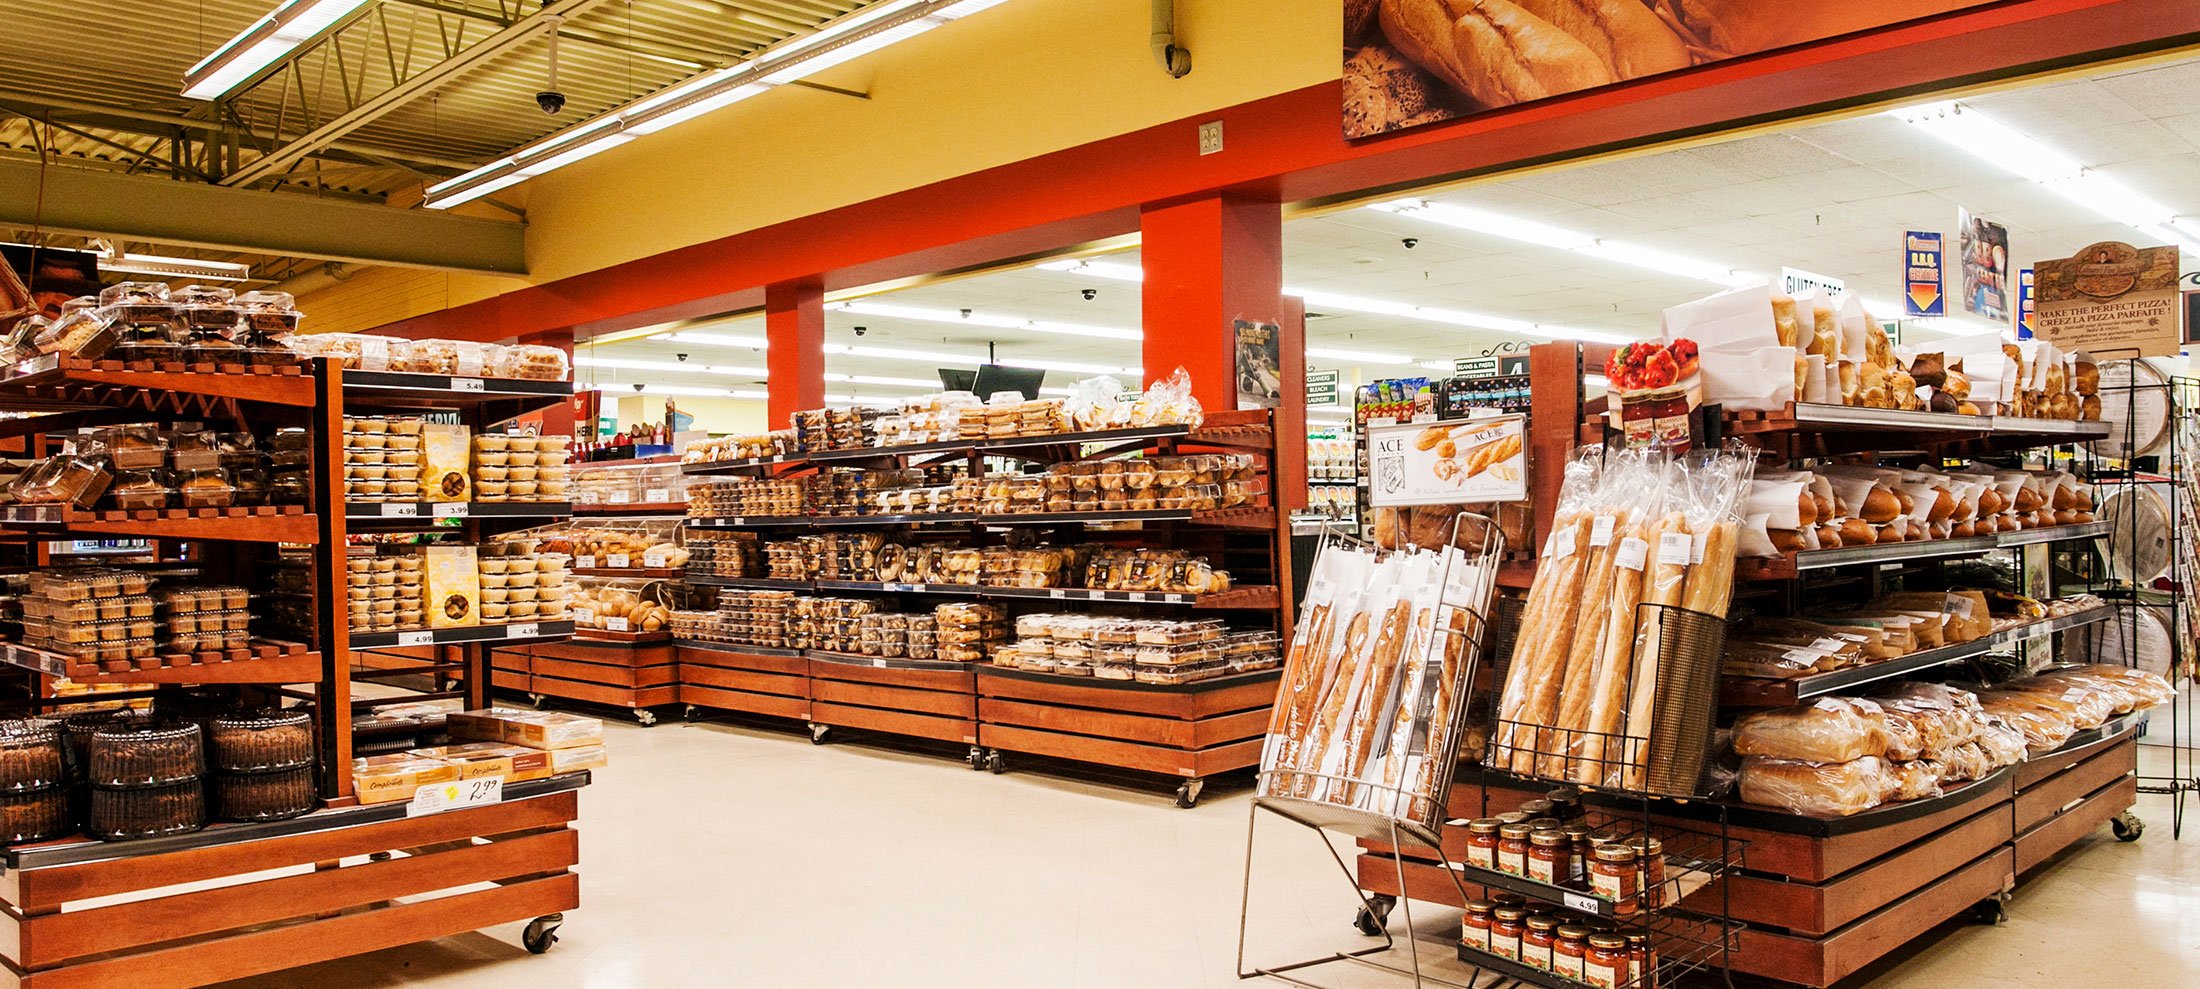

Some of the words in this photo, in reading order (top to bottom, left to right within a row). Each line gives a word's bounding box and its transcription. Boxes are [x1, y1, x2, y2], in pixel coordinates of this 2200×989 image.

[2040, 309, 2069, 320] MAKE
[2070, 307, 2090, 316] THE
[2091, 303, 2135, 314] PERFECT
[2138, 299, 2171, 309] PIZZA!
[2072, 315, 2086, 324] LA
[2087, 312, 2114, 322] PIZZA
[2117, 308, 2165, 320] PARFAITE
[1474, 430, 1494, 442] ACE
[1377, 438, 1404, 453] ACE
[1290, 721, 1303, 739] love
[470, 779, 498, 801] 2.99
[1579, 901, 1597, 912] 4.99
